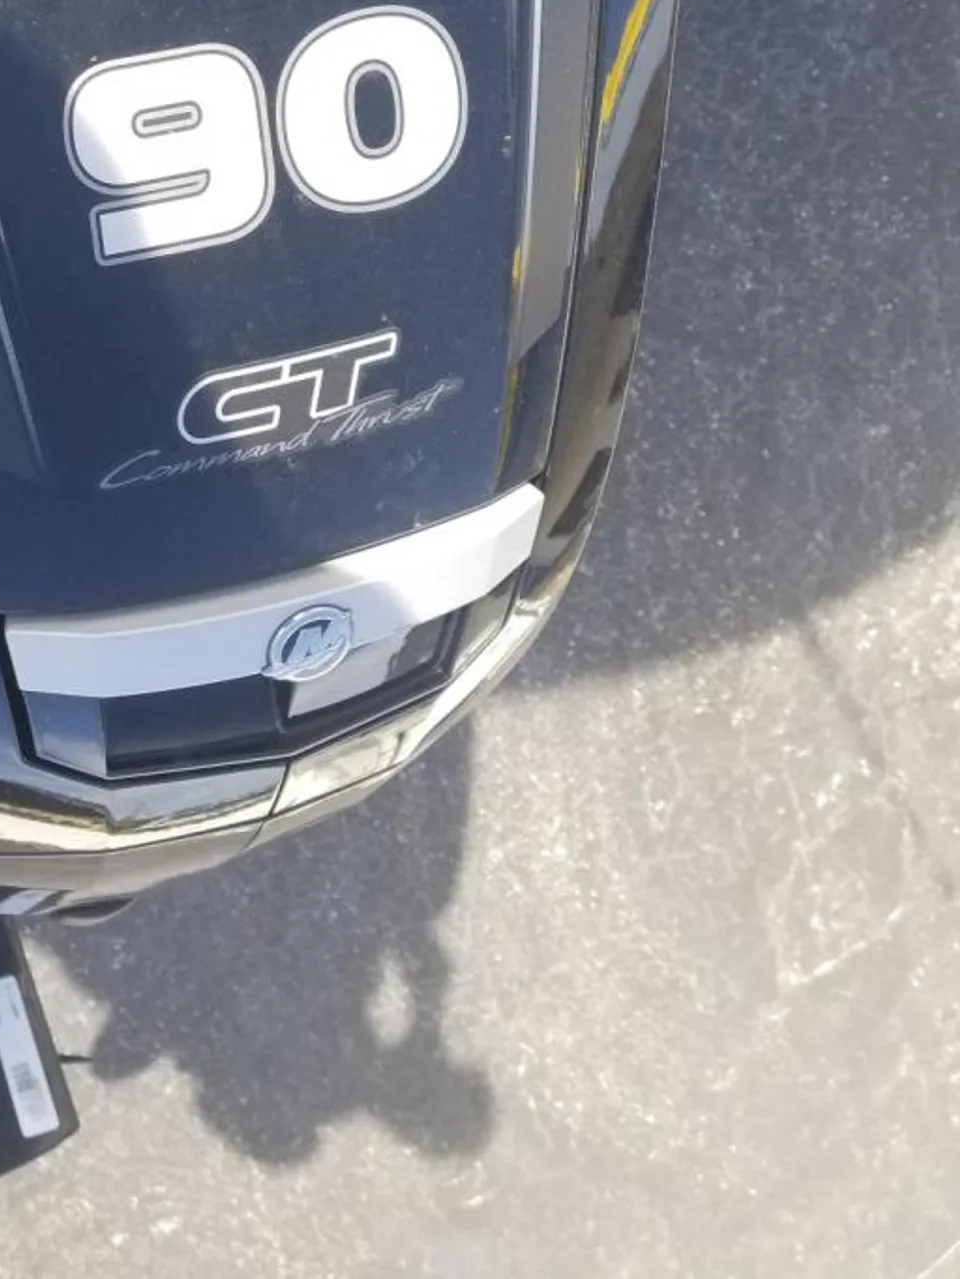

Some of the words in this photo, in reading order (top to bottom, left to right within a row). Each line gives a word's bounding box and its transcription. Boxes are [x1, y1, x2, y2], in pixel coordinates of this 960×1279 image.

[63, 4, 469, 266] 90
[99, 420, 322, 490] Command
[322, 378, 464, 442] Thrust
